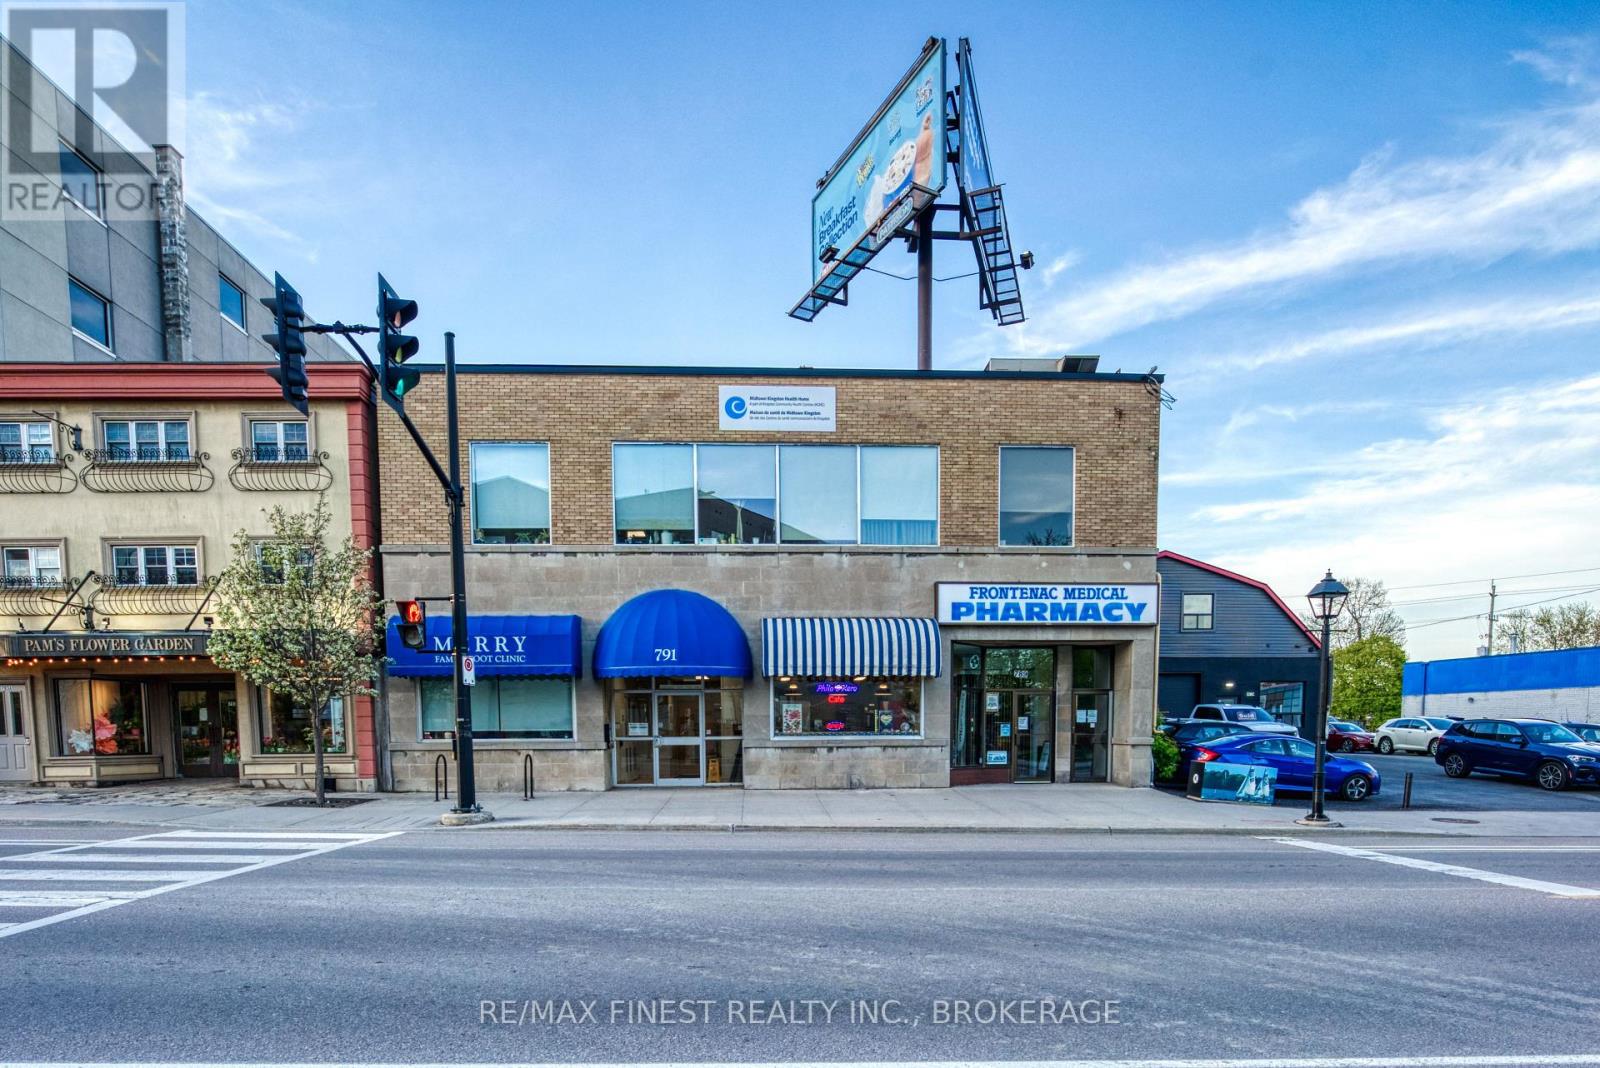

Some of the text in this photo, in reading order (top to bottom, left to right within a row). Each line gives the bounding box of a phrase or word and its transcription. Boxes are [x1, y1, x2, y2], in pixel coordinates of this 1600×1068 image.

[819, 196, 856, 244] Breakfast
[969, 587, 1128, 600] FRONTENAC MEDICAL
[951, 602, 1148, 621] PHARMACY
[24, 638, 194, 651] PAM'S FLOWER GARDEN
[433, 636, 527, 652] MRRY
[472, 654, 493, 663] OOT
[494, 654, 526, 663] CLINIC
[654, 648, 677, 661] 791
